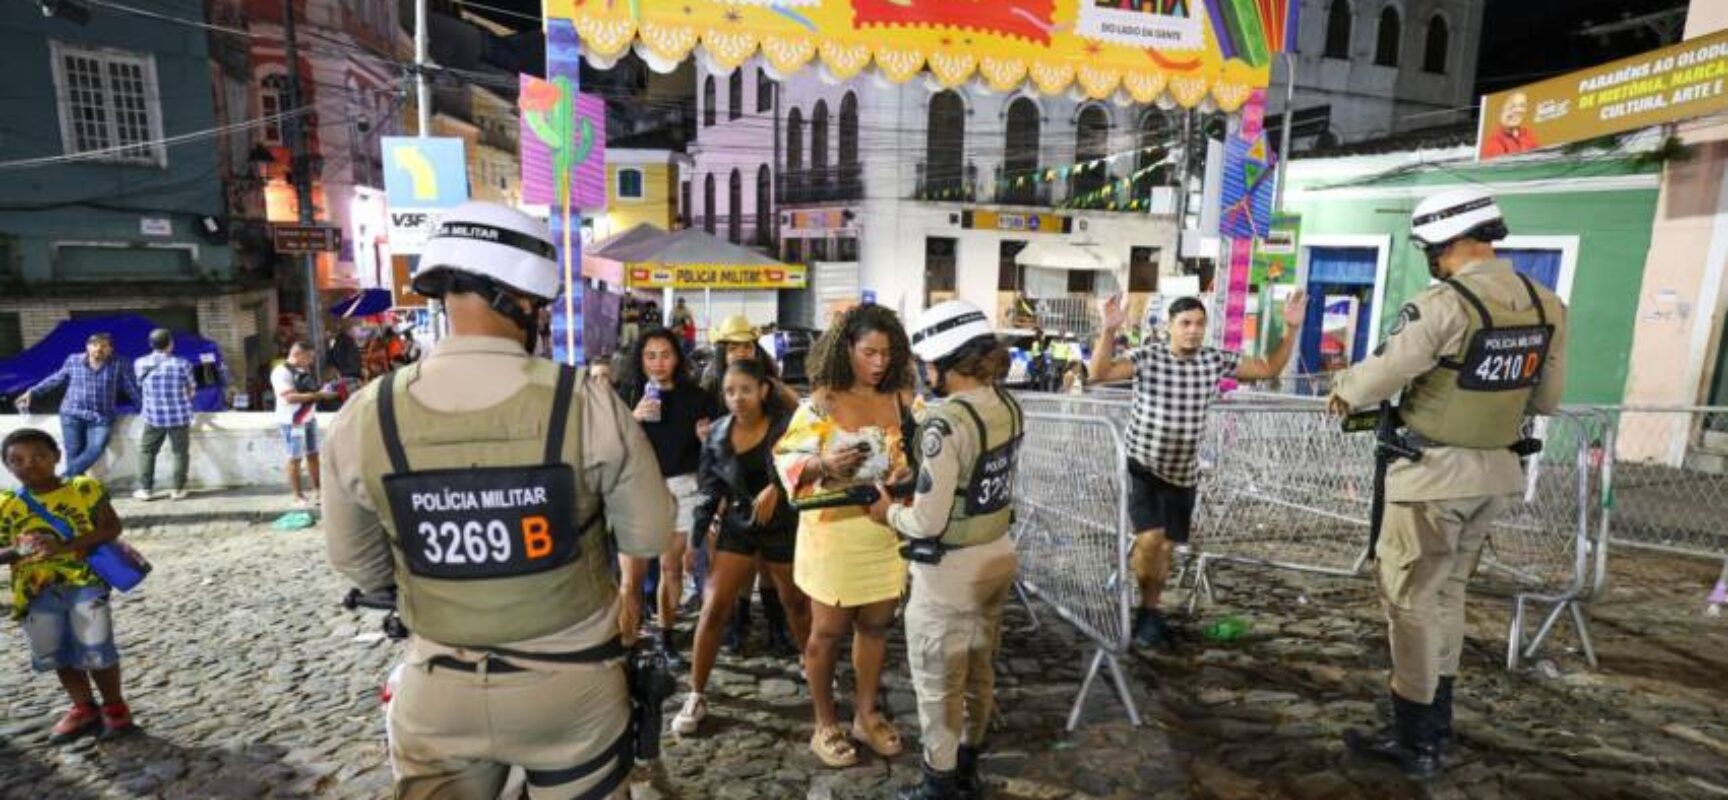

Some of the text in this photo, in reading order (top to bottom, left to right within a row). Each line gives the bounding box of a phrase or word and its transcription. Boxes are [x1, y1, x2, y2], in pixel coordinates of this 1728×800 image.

[1155, 29, 1182, 40] GENTE
[1652, 60, 1674, 74] AO
[1579, 94, 1596, 110] DE
[1672, 83, 1712, 104] ARTE
[1714, 80, 1724, 94] E
[451, 221, 499, 241] MILITAR
[1475, 355, 1523, 380] 4210
[412, 485, 548, 512] POLÍCIA MILITAR
[417, 514, 555, 565] 3269 B
